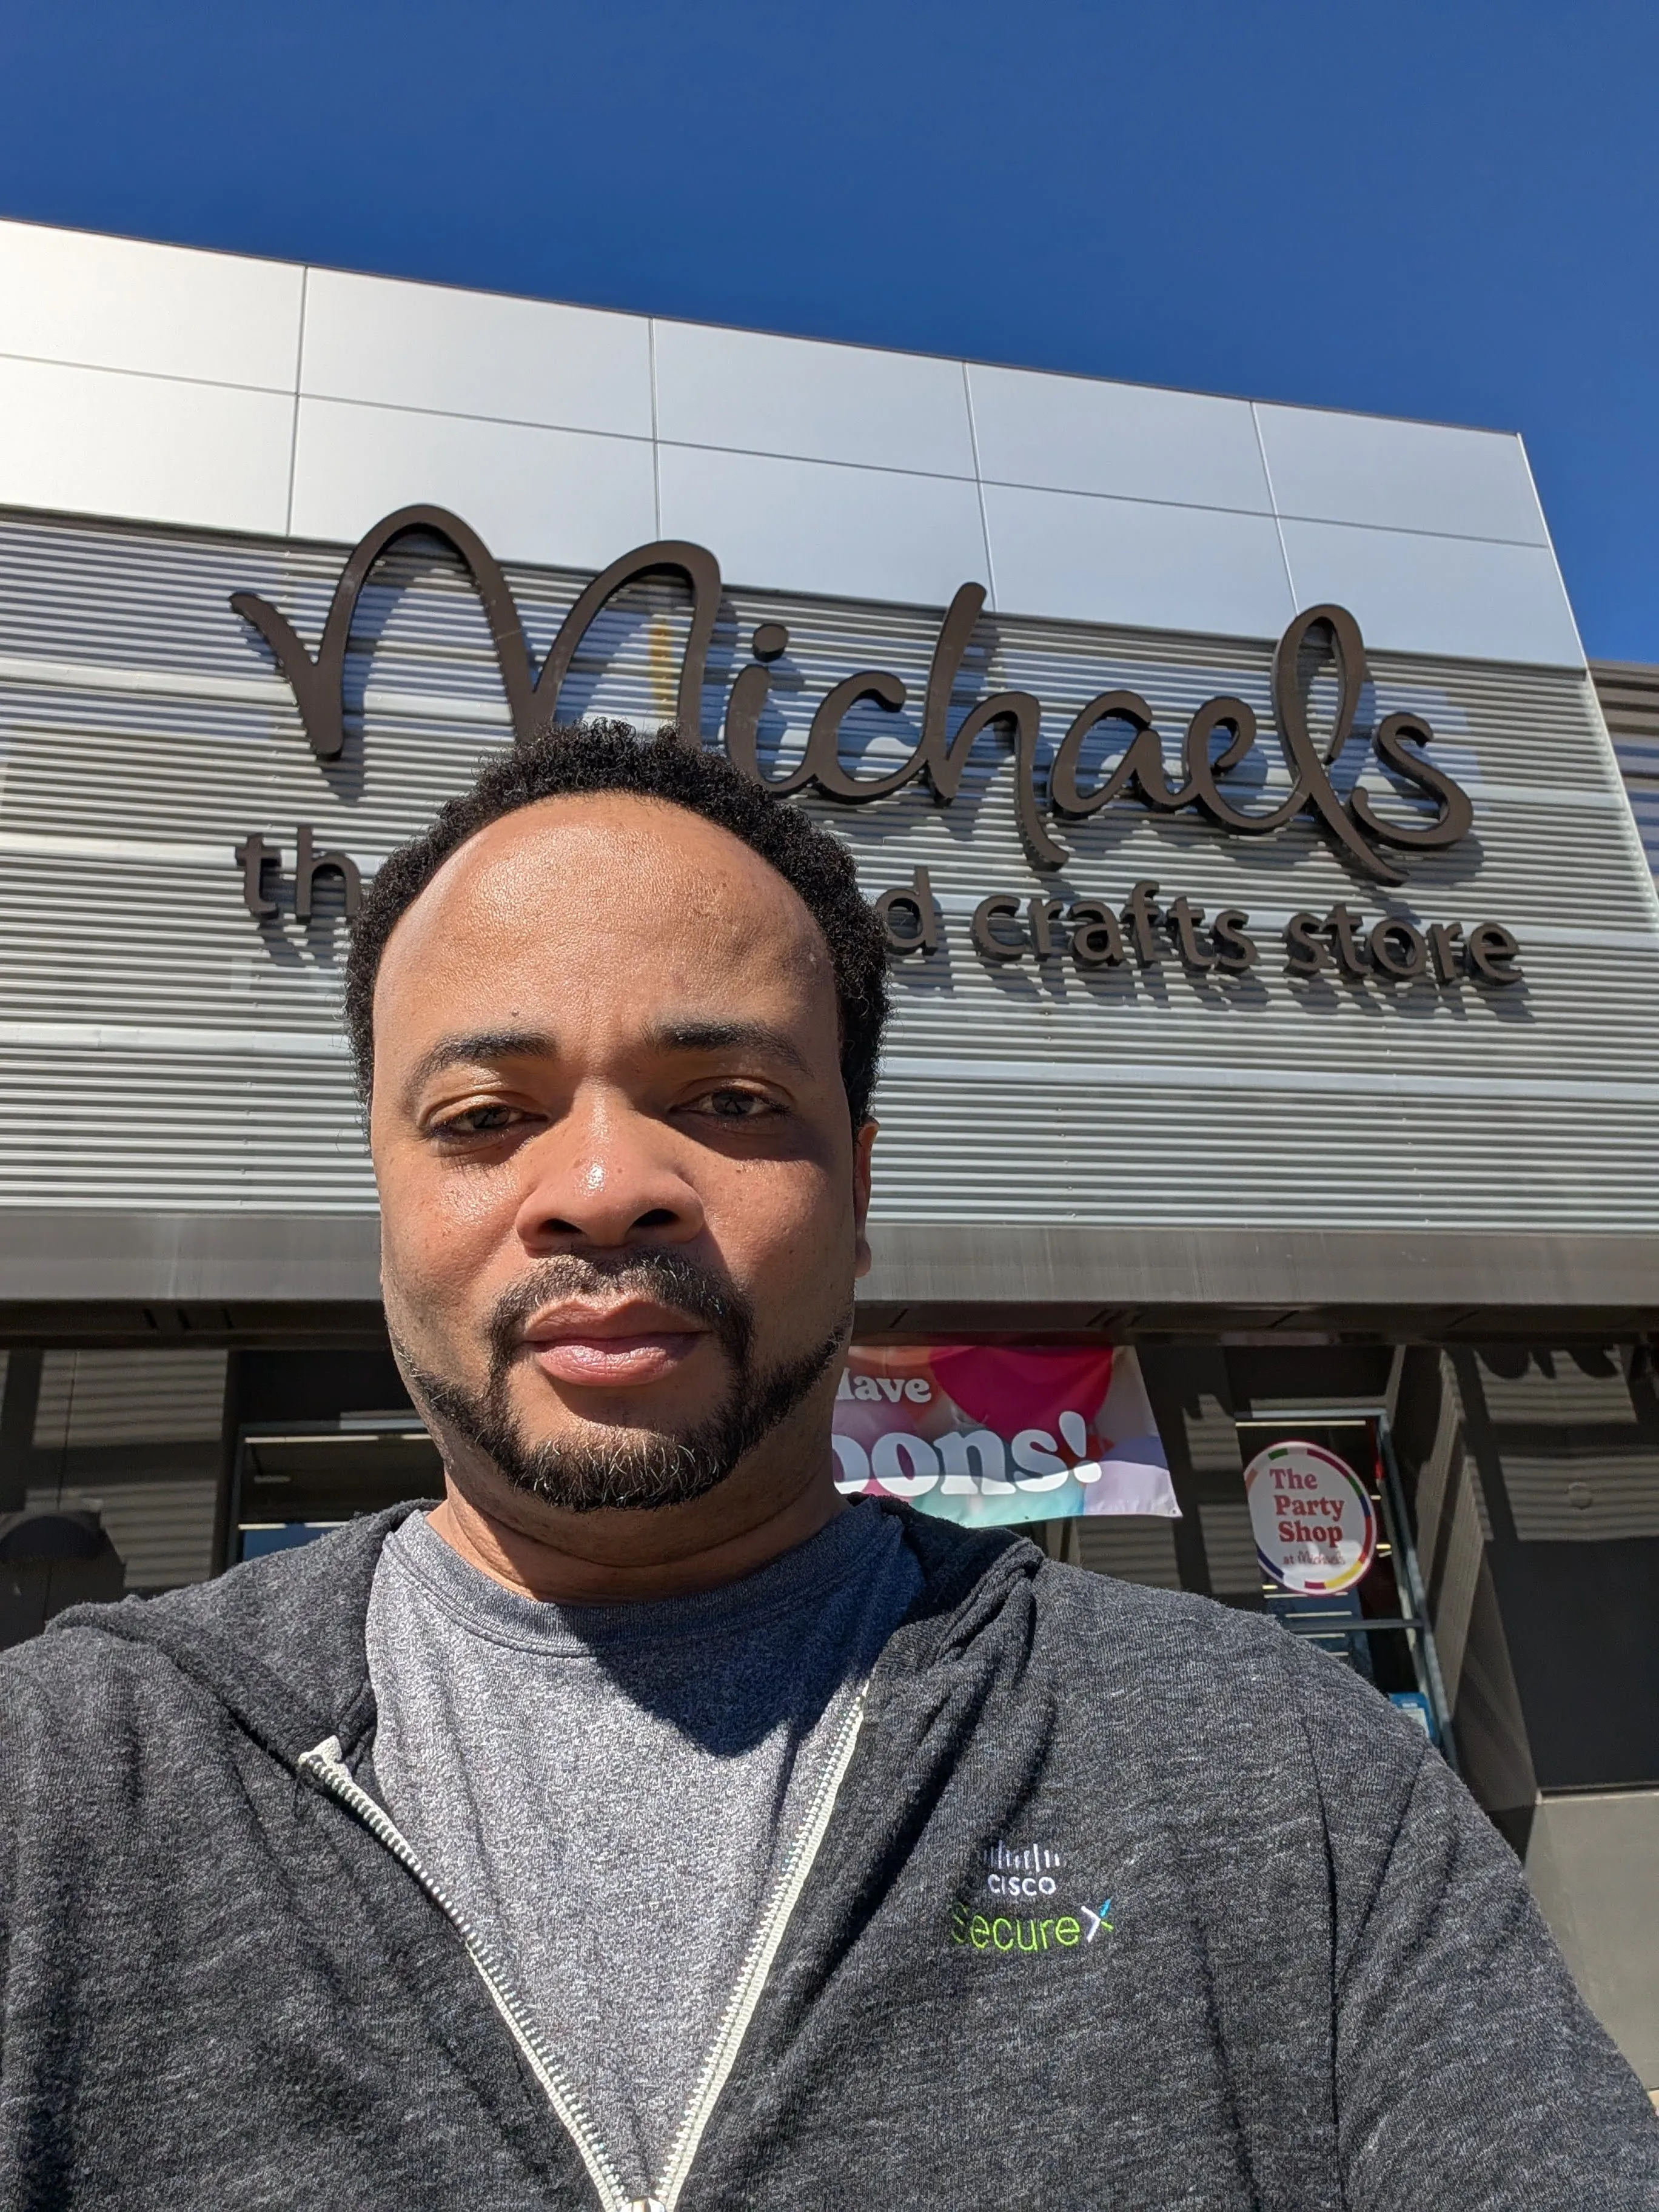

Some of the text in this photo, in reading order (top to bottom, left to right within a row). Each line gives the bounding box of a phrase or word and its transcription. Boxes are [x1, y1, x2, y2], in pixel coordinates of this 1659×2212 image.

[230, 504, 1472, 887] Michaels
[235, 824, 363, 924] th
[972, 880, 1259, 970] crafts
[1282, 902, 1523, 985] store
[831, 1410, 1102, 1496] oons!
[1270, 1468, 1318, 1490] The
[1273, 1495, 1345, 1522] Party
[1278, 1520, 1343, 1548] Shop
